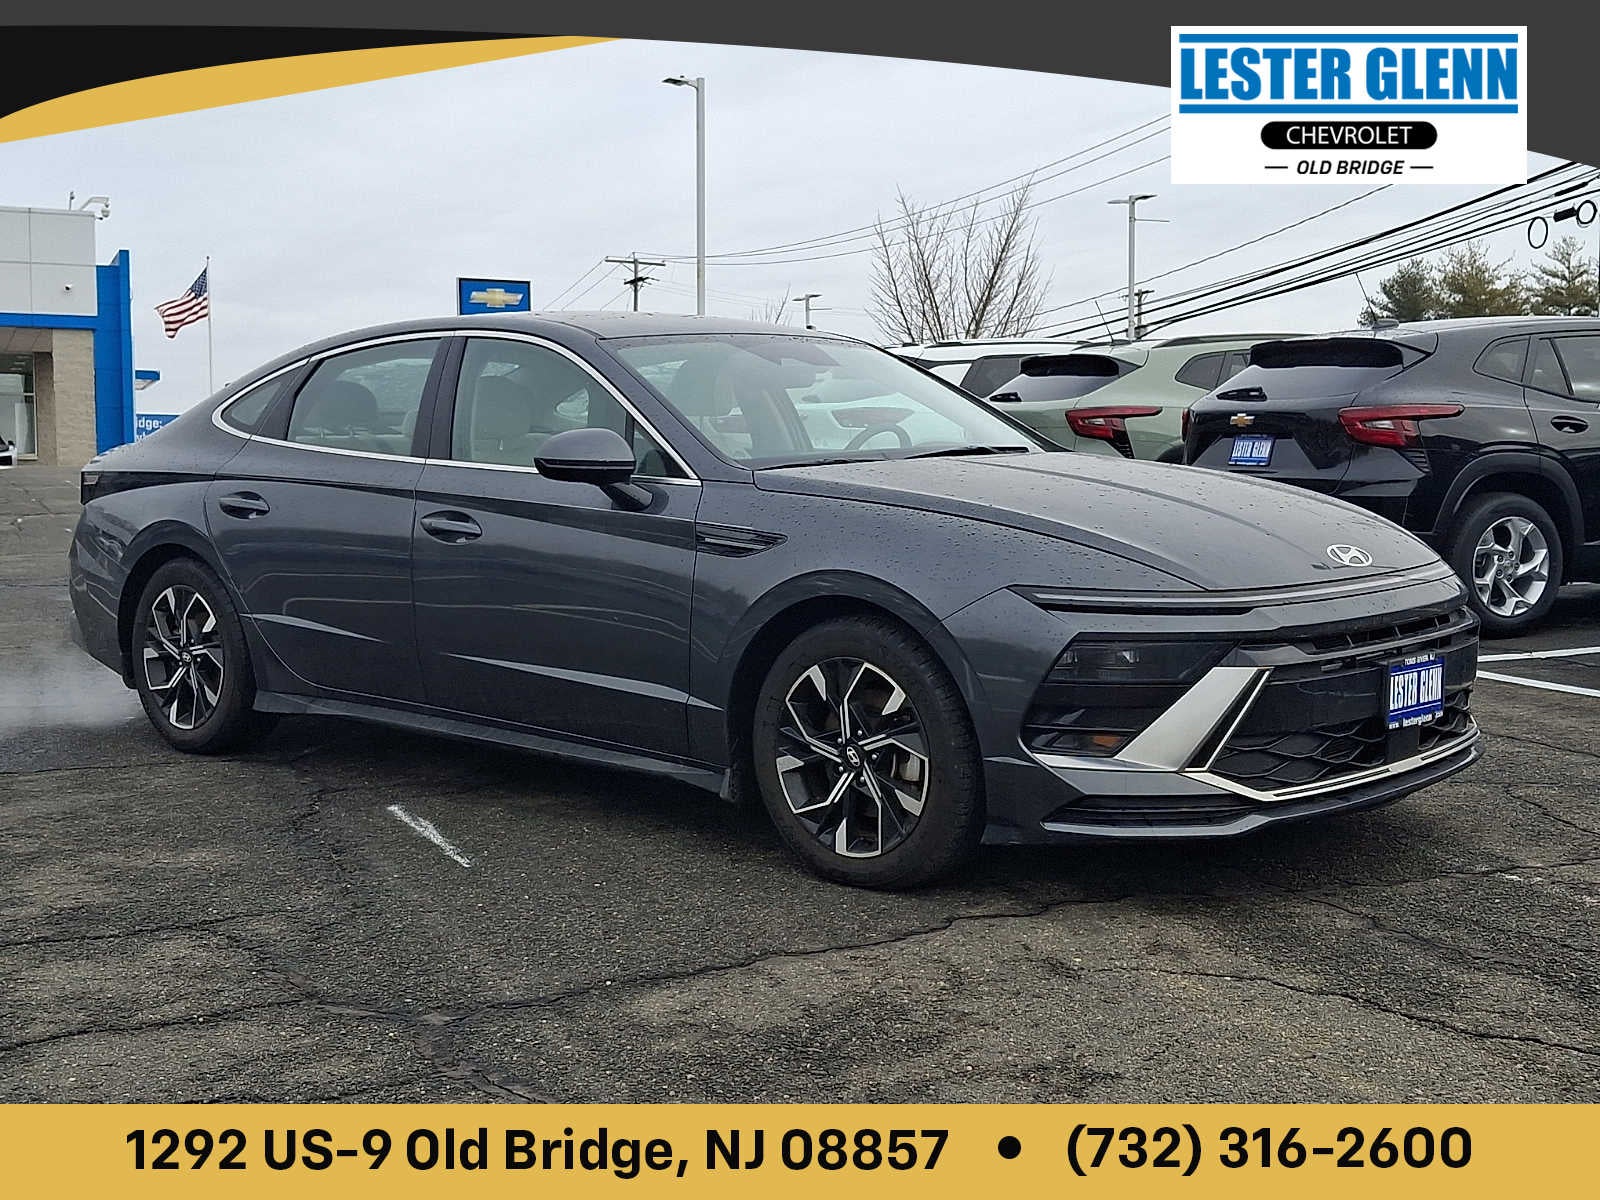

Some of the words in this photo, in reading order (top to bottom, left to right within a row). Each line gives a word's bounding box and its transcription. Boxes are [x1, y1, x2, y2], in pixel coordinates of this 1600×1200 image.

[1231, 441, 1253, 458] LESTER
[1390, 671, 1418, 710] LESTER
[1420, 667, 1442, 703] GLENN
